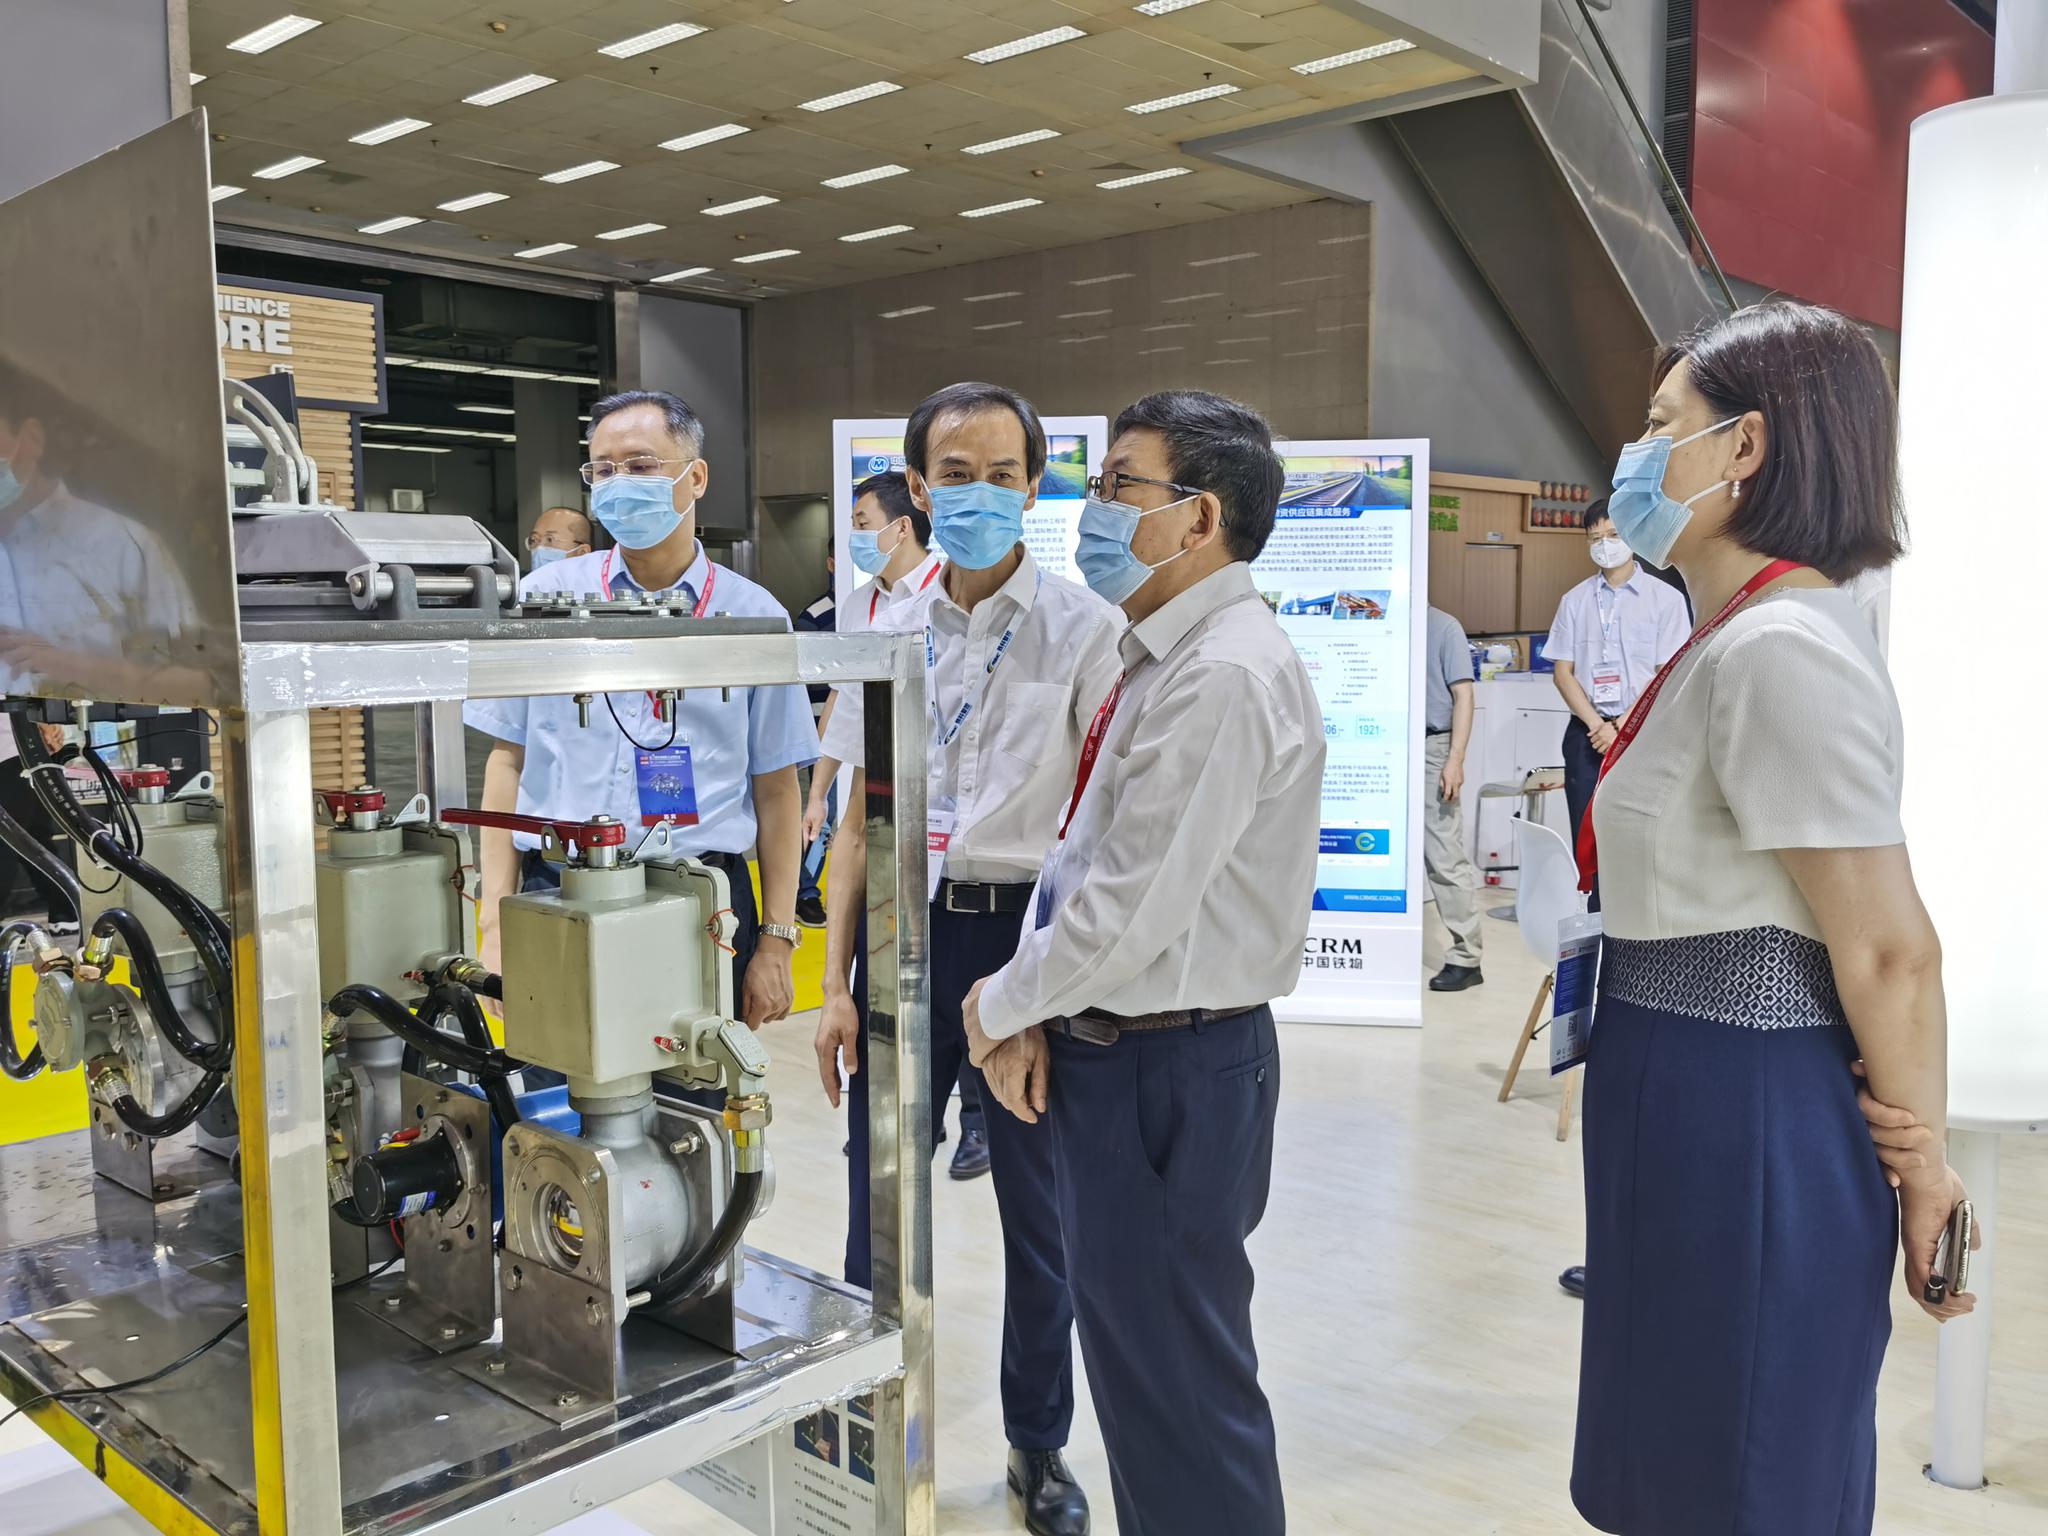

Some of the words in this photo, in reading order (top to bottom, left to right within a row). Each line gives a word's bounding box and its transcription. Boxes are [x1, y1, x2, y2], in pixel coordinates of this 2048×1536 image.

[1304, 938, 1363, 955] CRM
[1302, 956, 1363, 970] 中国铁物
